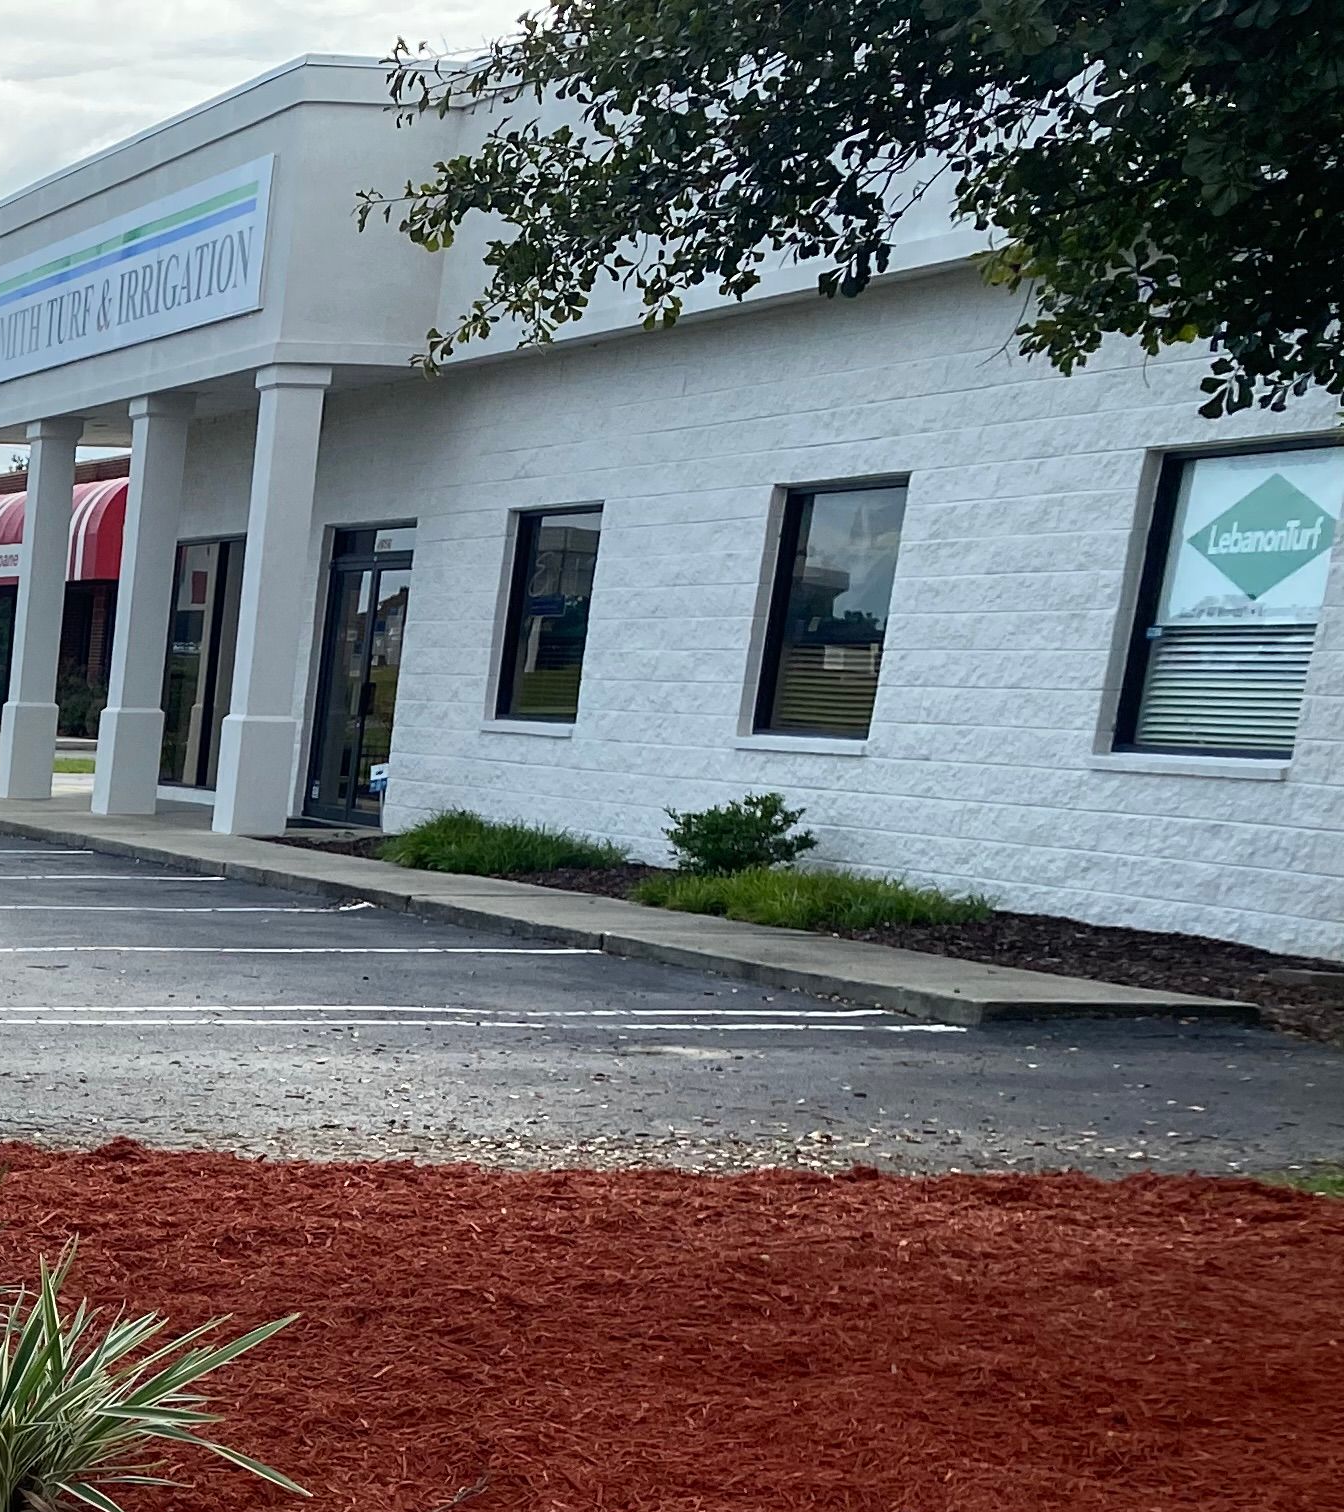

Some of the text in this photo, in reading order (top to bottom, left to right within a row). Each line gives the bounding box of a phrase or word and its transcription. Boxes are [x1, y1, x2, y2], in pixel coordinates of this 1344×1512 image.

[45, 284, 95, 350] TURF
[96, 278, 113, 332] &
[115, 226, 256, 327] IRRIGATION
[1207, 516, 1326, 555] LebanonTurf
